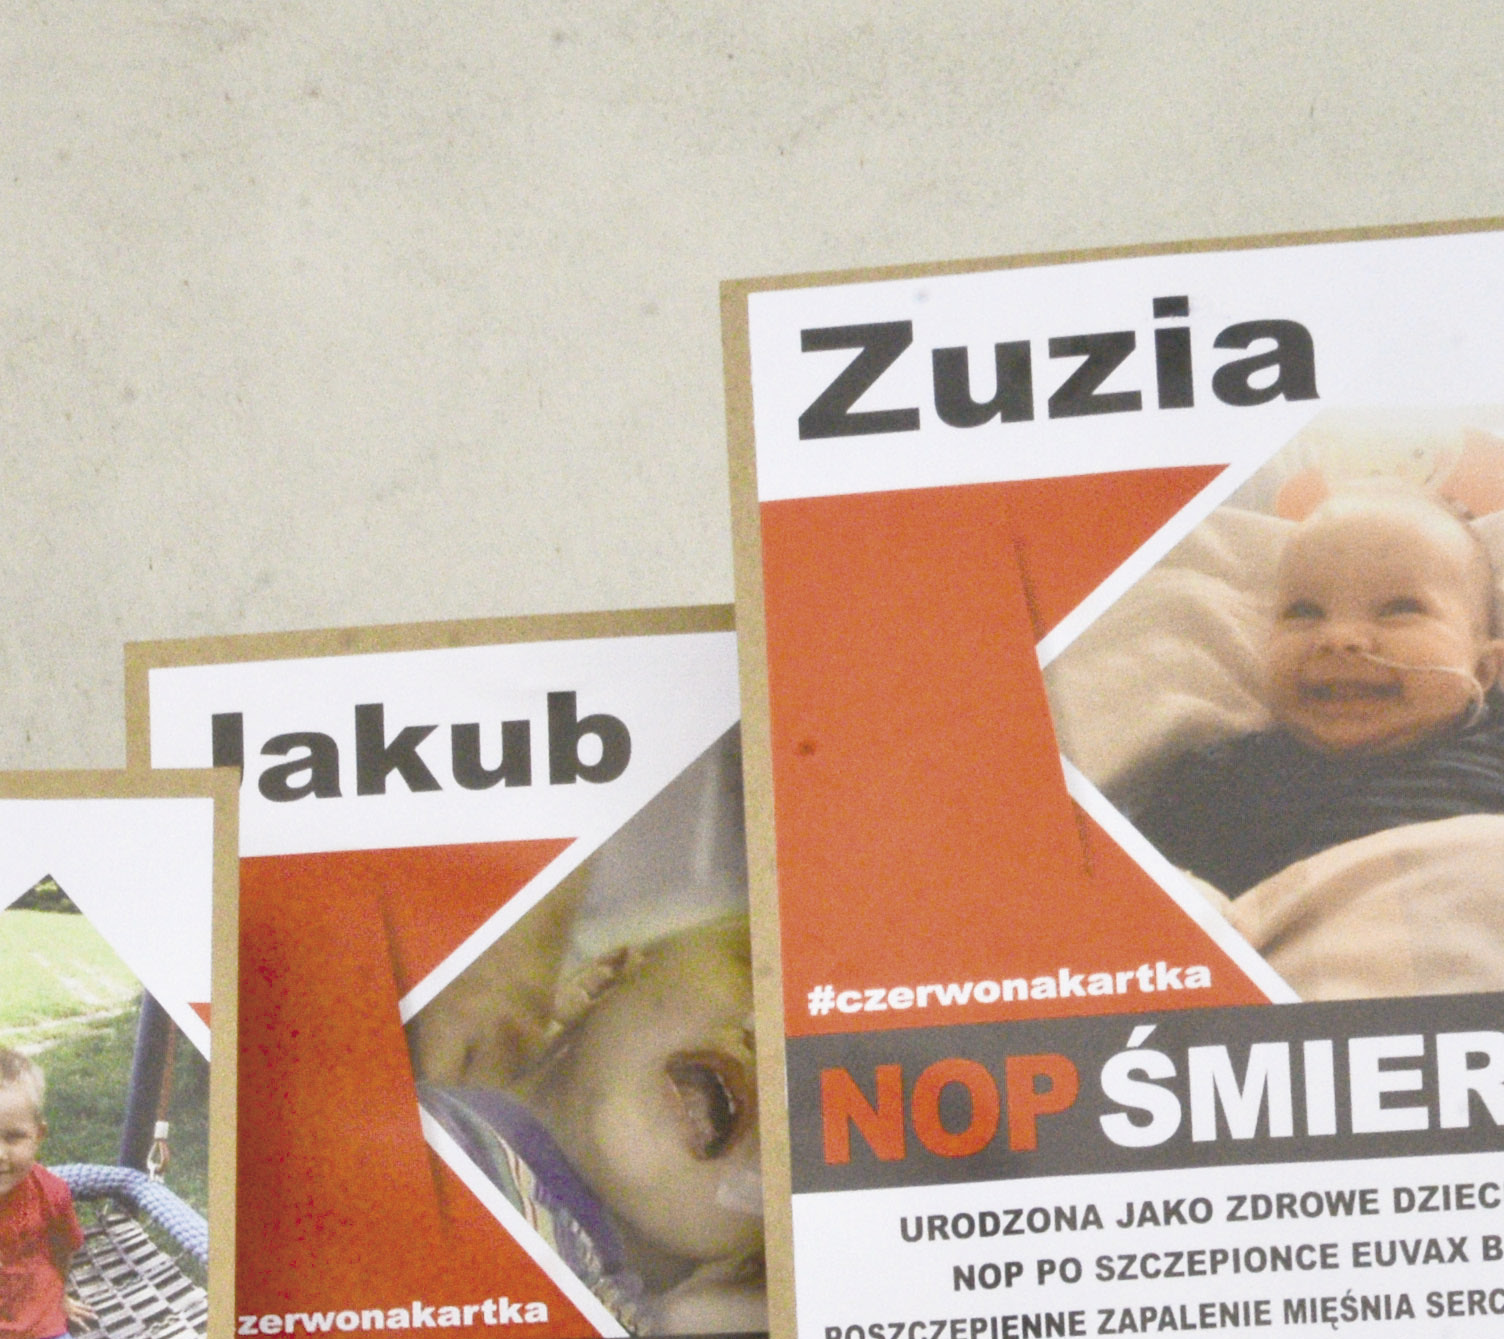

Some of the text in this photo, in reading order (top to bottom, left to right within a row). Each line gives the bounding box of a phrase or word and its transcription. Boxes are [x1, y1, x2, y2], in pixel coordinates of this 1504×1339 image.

[798, 294, 1322, 441] Zuzia
[808, 960, 1213, 1017] #czerwonakartka
[820, 1053, 1080, 1166] NOP
[899, 1201, 1105, 1244] URODZONA
[1116, 1197, 1214, 1230] JAKO
[1225, 1187, 1380, 1224] ZDROWE
[952, 1234, 1504, 1293] NOP PO SZCZEPIONCE EUVAX B
[237, 1298, 549, 1336] zerwonakartka
[1097, 1298, 1273, 1337] ZAPALENIE
[1283, 1286, 1417, 1333] MIĘŚNIA
